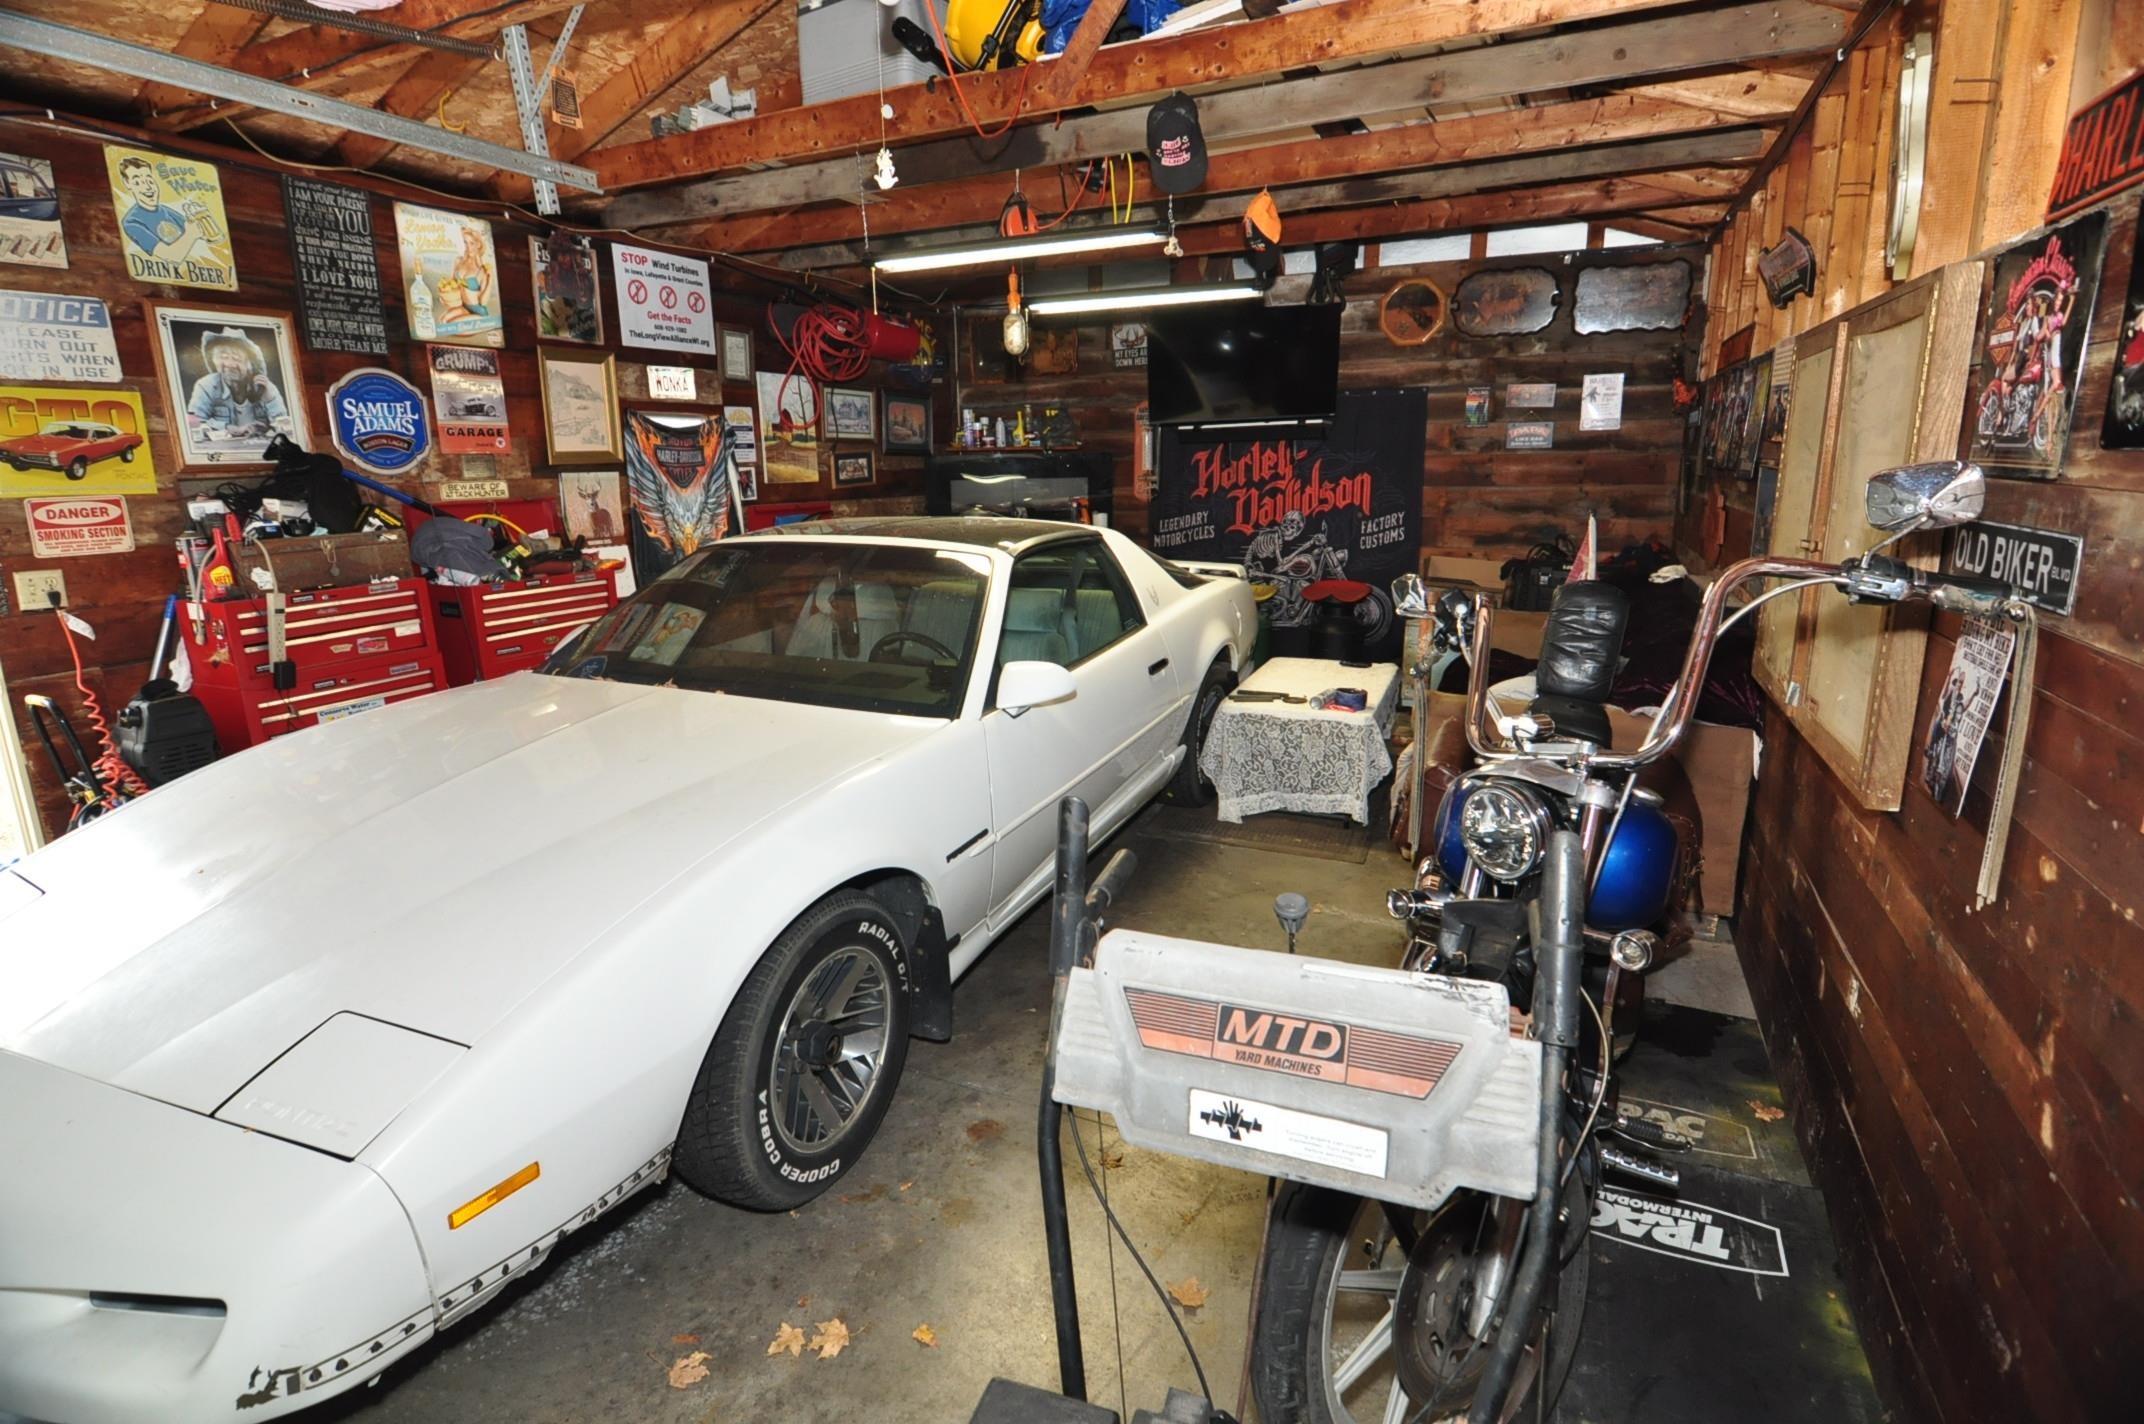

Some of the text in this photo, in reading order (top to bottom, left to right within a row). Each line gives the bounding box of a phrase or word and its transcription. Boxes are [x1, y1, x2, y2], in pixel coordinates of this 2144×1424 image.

[156, 163, 196, 179] Save
[168, 178, 218, 194] Water
[295, 188, 312, 202] AM
[333, 207, 370, 236] YOU
[130, 253, 183, 280] DRINK
[621, 252, 700, 277] STOP Wind Turbines
[301, 268, 378, 291] I LOVE YOU!
[0, 296, 101, 325] OTICE
[647, 310, 692, 325] Get the Facts
[59, 341, 98, 352] OUT
[311, 336, 389, 354] MORE THAN ME
[61, 353, 115, 366] WHEN
[42, 366, 61, 378] IN
[73, 367, 110, 378] USE
[0, 396, 138, 438] GTO
[343, 398, 419, 420] SAMUEL
[352, 417, 416, 436] ADAMS
[446, 427, 504, 437] GARAGE
[446, 489, 506, 498] ATTACK HUNTER
[447, 482, 501, 491] BEWARE OF
[46, 507, 110, 520] DANGER
[1159, 511, 1209, 533] LEGENDARY
[1361, 512, 1405, 534] FACTORY
[37, 526, 127, 542] SMOKING SECTION
[1153, 525, 1215, 548] MOTORCYCLES
[1359, 528, 1405, 550] CUSTOMS
[1955, 529, 2071, 594] OLD BIKER BLVD
[858, 921, 899, 960] RADIAL
[1223, 1008, 1343, 1060] MTD
[1235, 1049, 1322, 1077] YARD MACHINES
[758, 1088, 840, 1183] COOPER COBRA
[1597, 1190, 1712, 1224] INTERMODAL
[1590, 1199, 1730, 1260] TRAC
